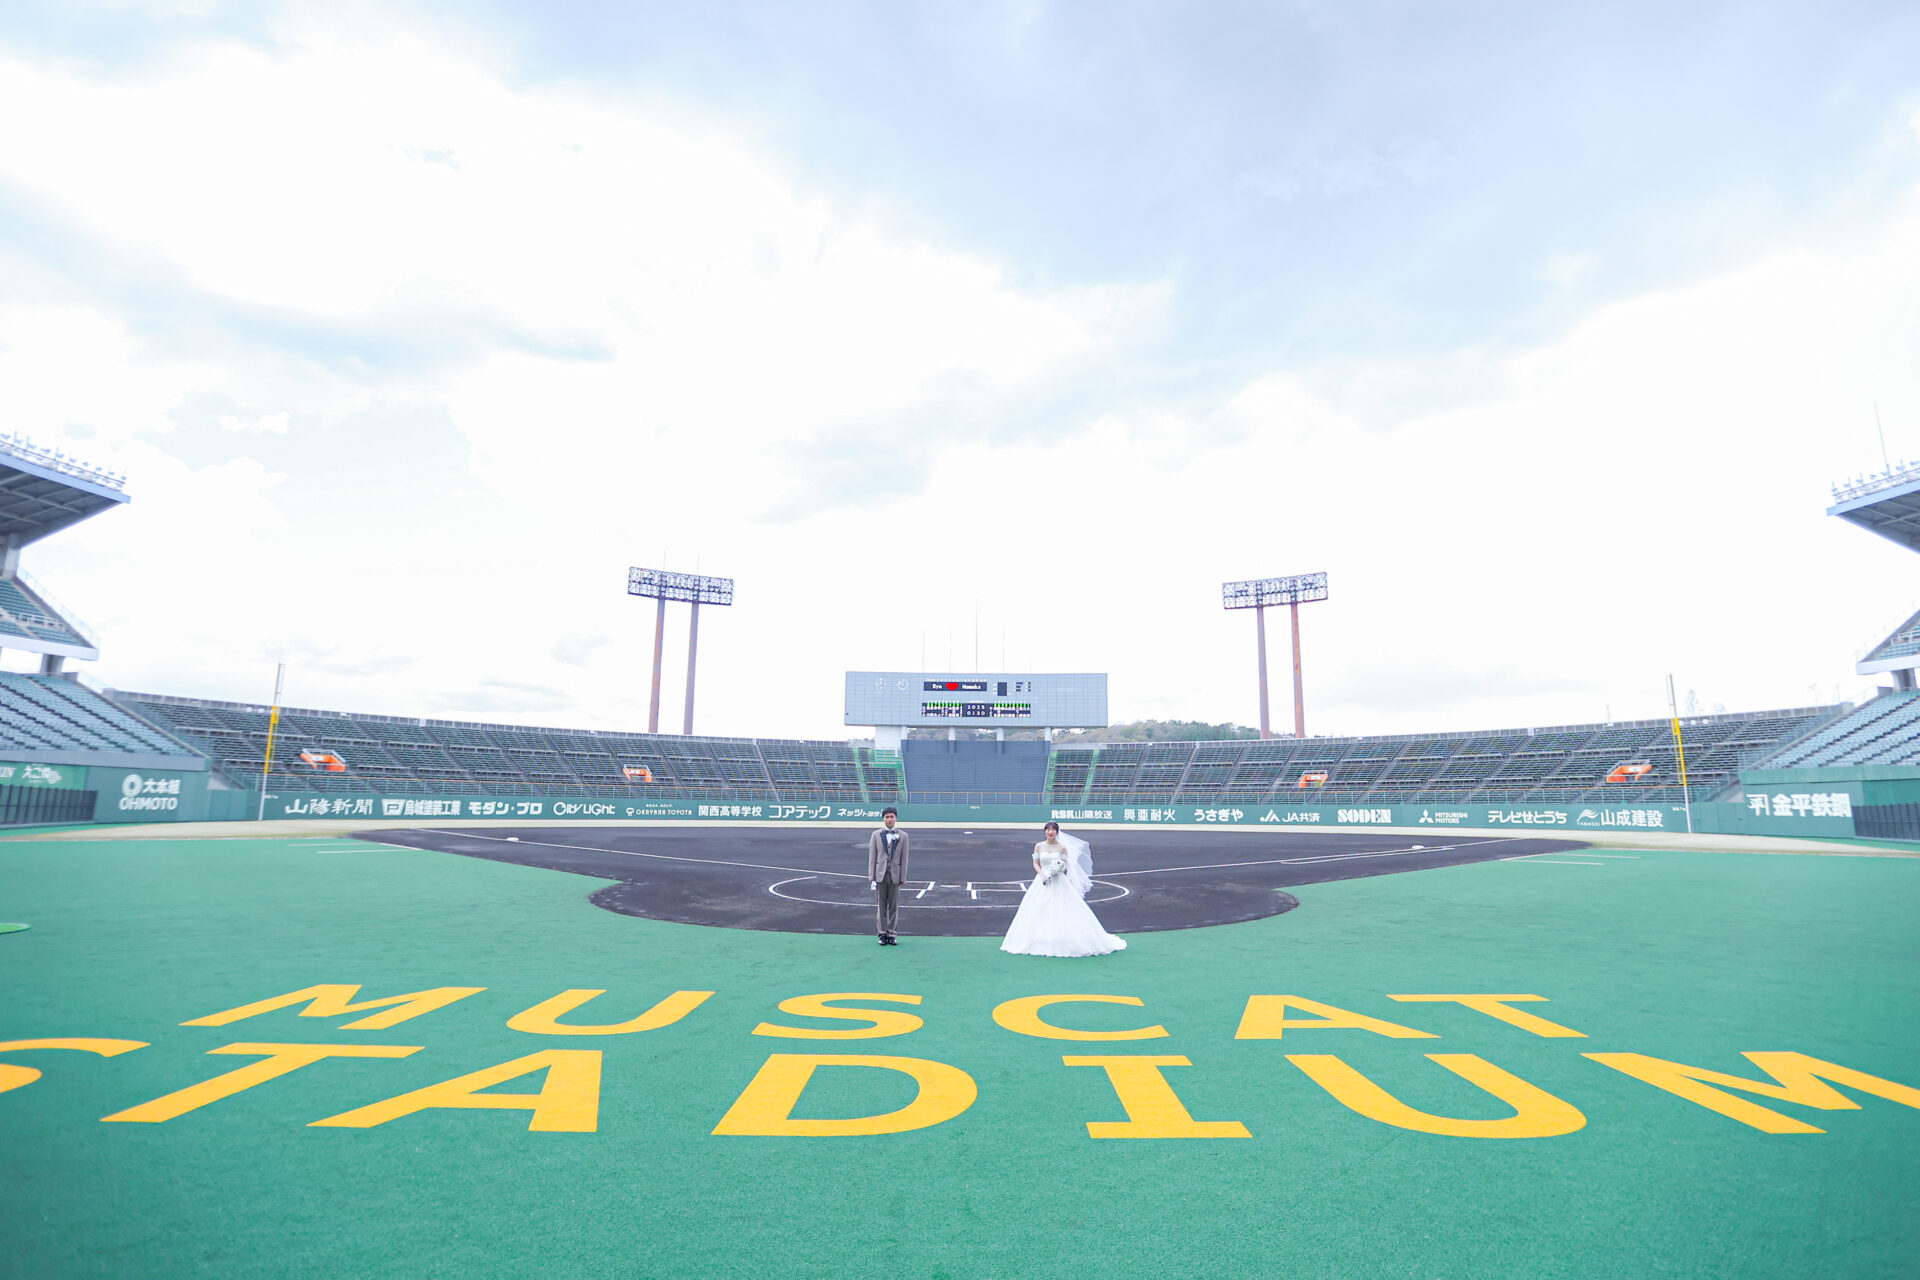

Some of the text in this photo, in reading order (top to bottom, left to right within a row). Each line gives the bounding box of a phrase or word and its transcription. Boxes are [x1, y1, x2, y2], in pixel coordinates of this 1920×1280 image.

[142, 778, 181, 794] 大本組
[119, 797, 178, 810] OHMOTO
[284, 798, 373, 815] 山陽新聞
[469, 801, 542, 815] モダン・プロ
[698, 805, 762, 817] 関西高等学校
[768, 804, 831, 818] コアテック
[837, 807, 883, 817] ネッツトヨタ
[1194, 808, 1243, 822] うさぎや
[1283, 811, 1320, 822] JA共済
[1338, 808, 1392, 824] SODEN
[1488, 810, 1567, 825] テレビせとうち
[1600, 809, 1664, 827] 山成建設
[179, 984, 1588, 1040] MUSCAT
[0, 1037, 1920, 1138] STADIUM
